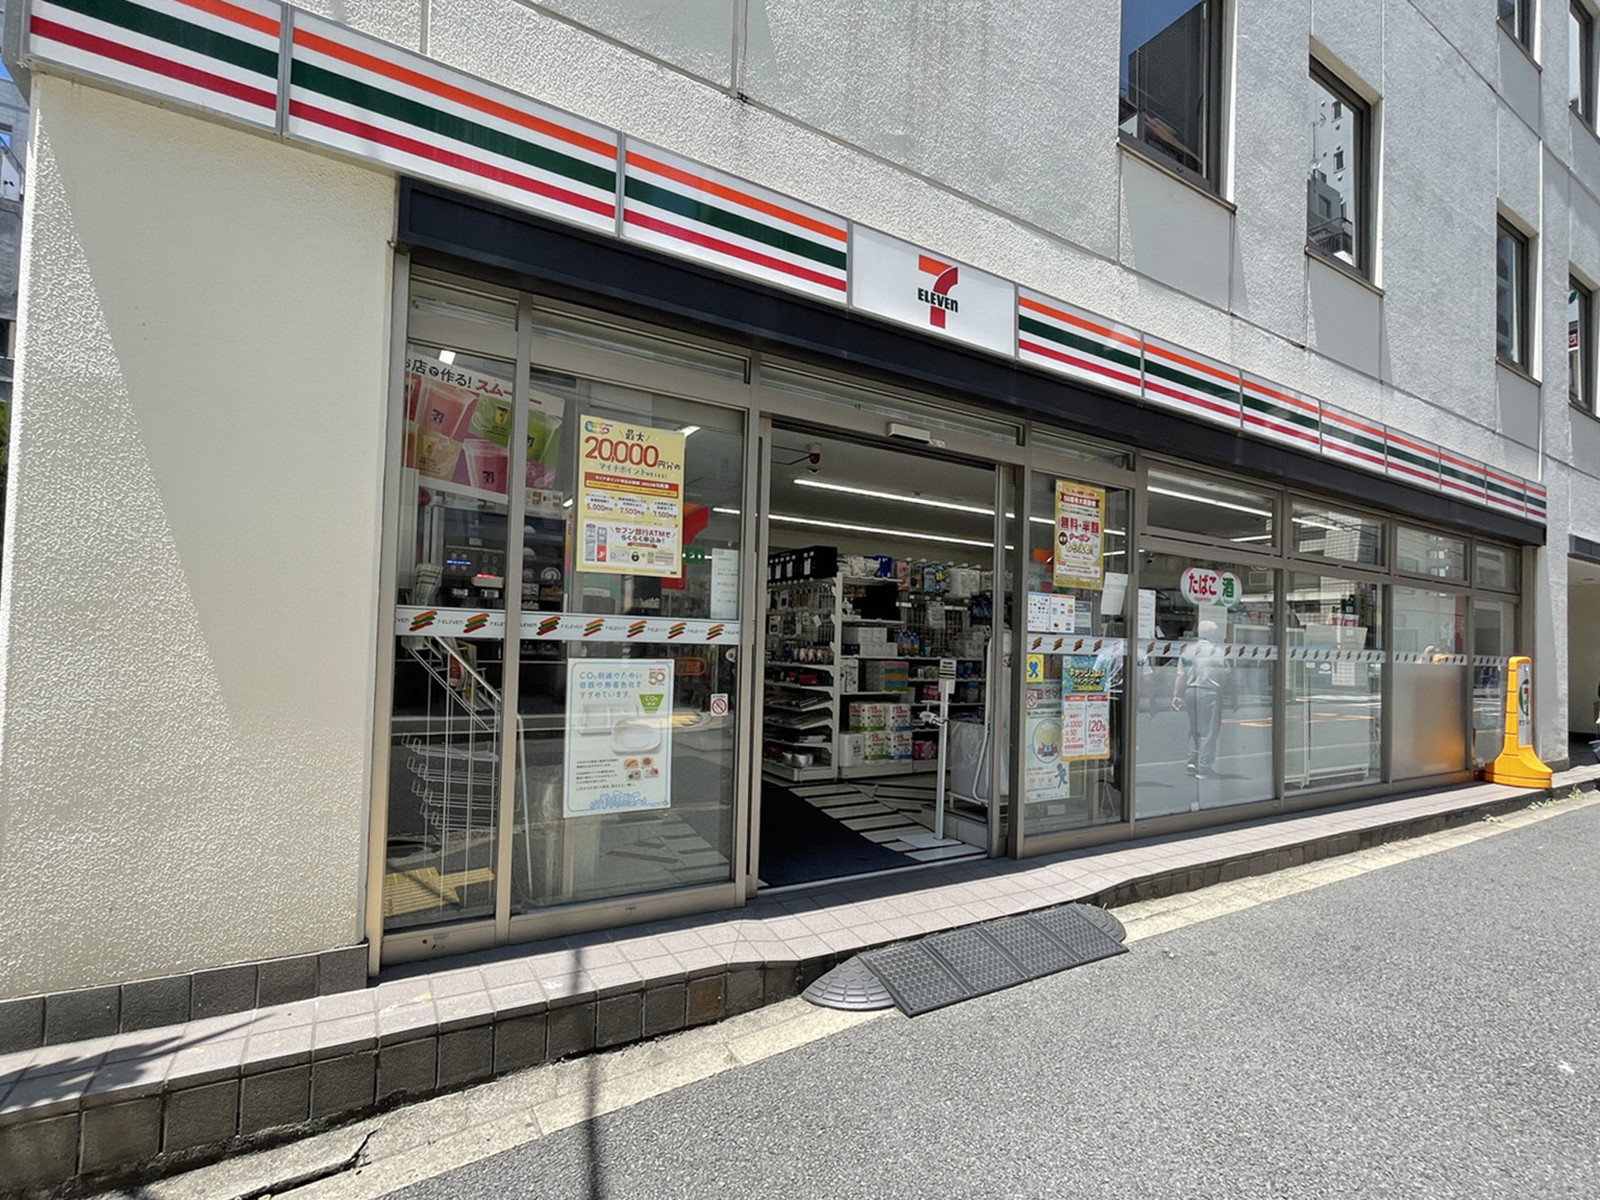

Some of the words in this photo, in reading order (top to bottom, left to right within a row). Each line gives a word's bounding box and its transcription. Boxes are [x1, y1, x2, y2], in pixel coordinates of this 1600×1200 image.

[919, 254, 958, 329] 7
[625, 429, 645, 441] 最大
[615, 527, 671, 539] セブン銀行ATMで
[1188, 573, 1217, 596] たばこ
[1222, 577, 1234, 598] 酒
